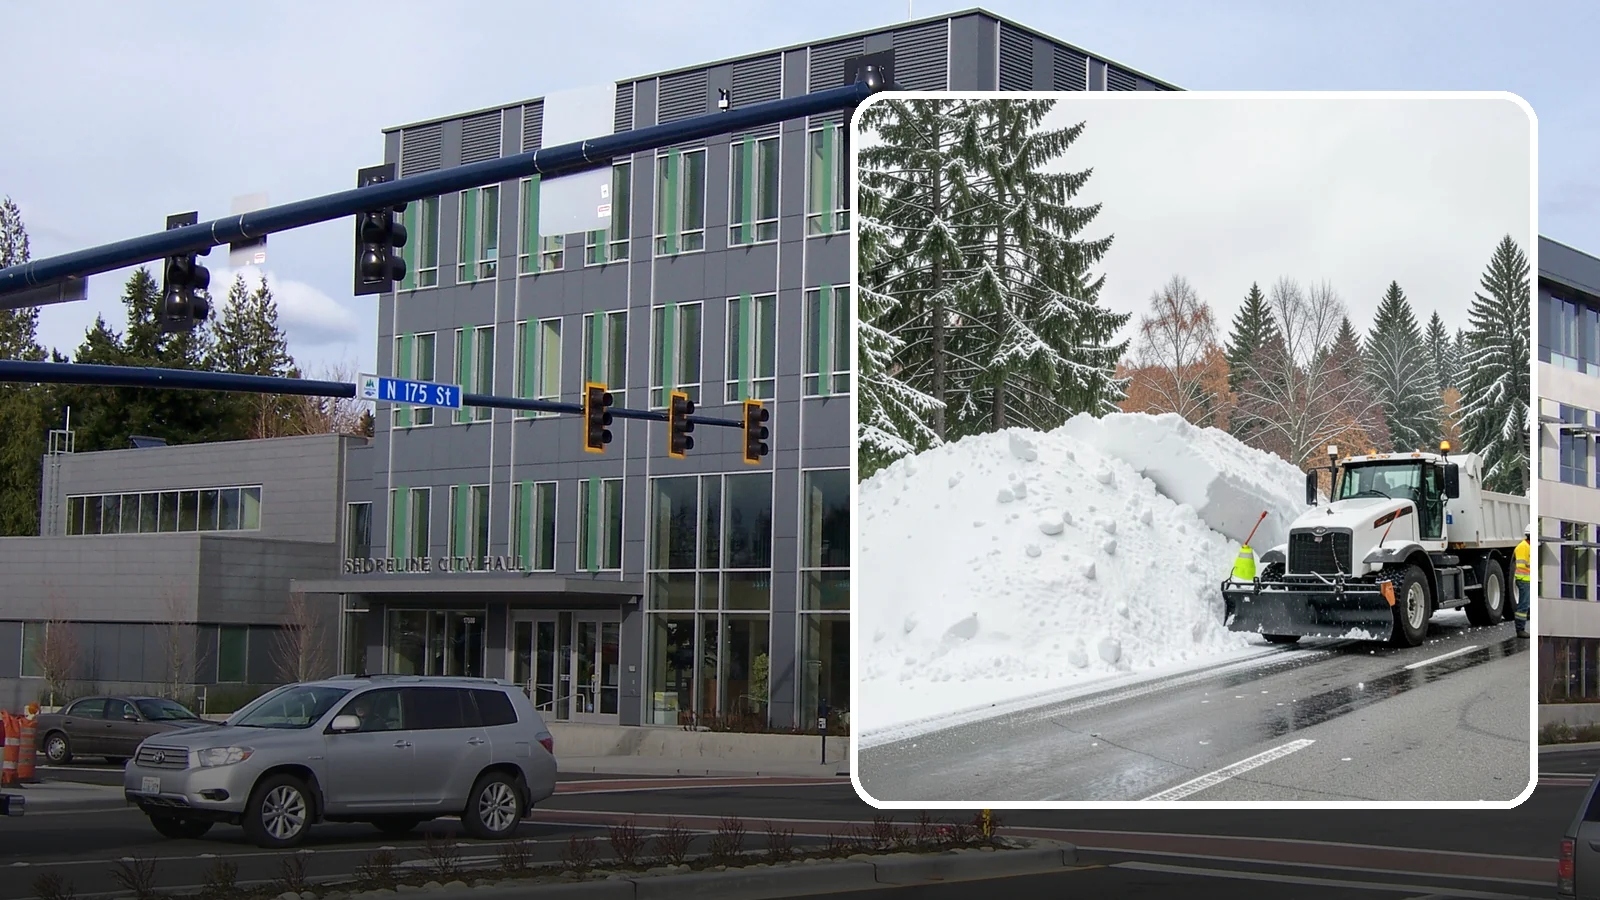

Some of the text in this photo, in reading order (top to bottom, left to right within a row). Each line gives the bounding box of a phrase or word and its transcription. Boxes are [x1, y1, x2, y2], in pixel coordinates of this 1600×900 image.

[387, 380, 451, 406] N 175 St
[344, 555, 525, 574] SHORELINE CITY HALL
